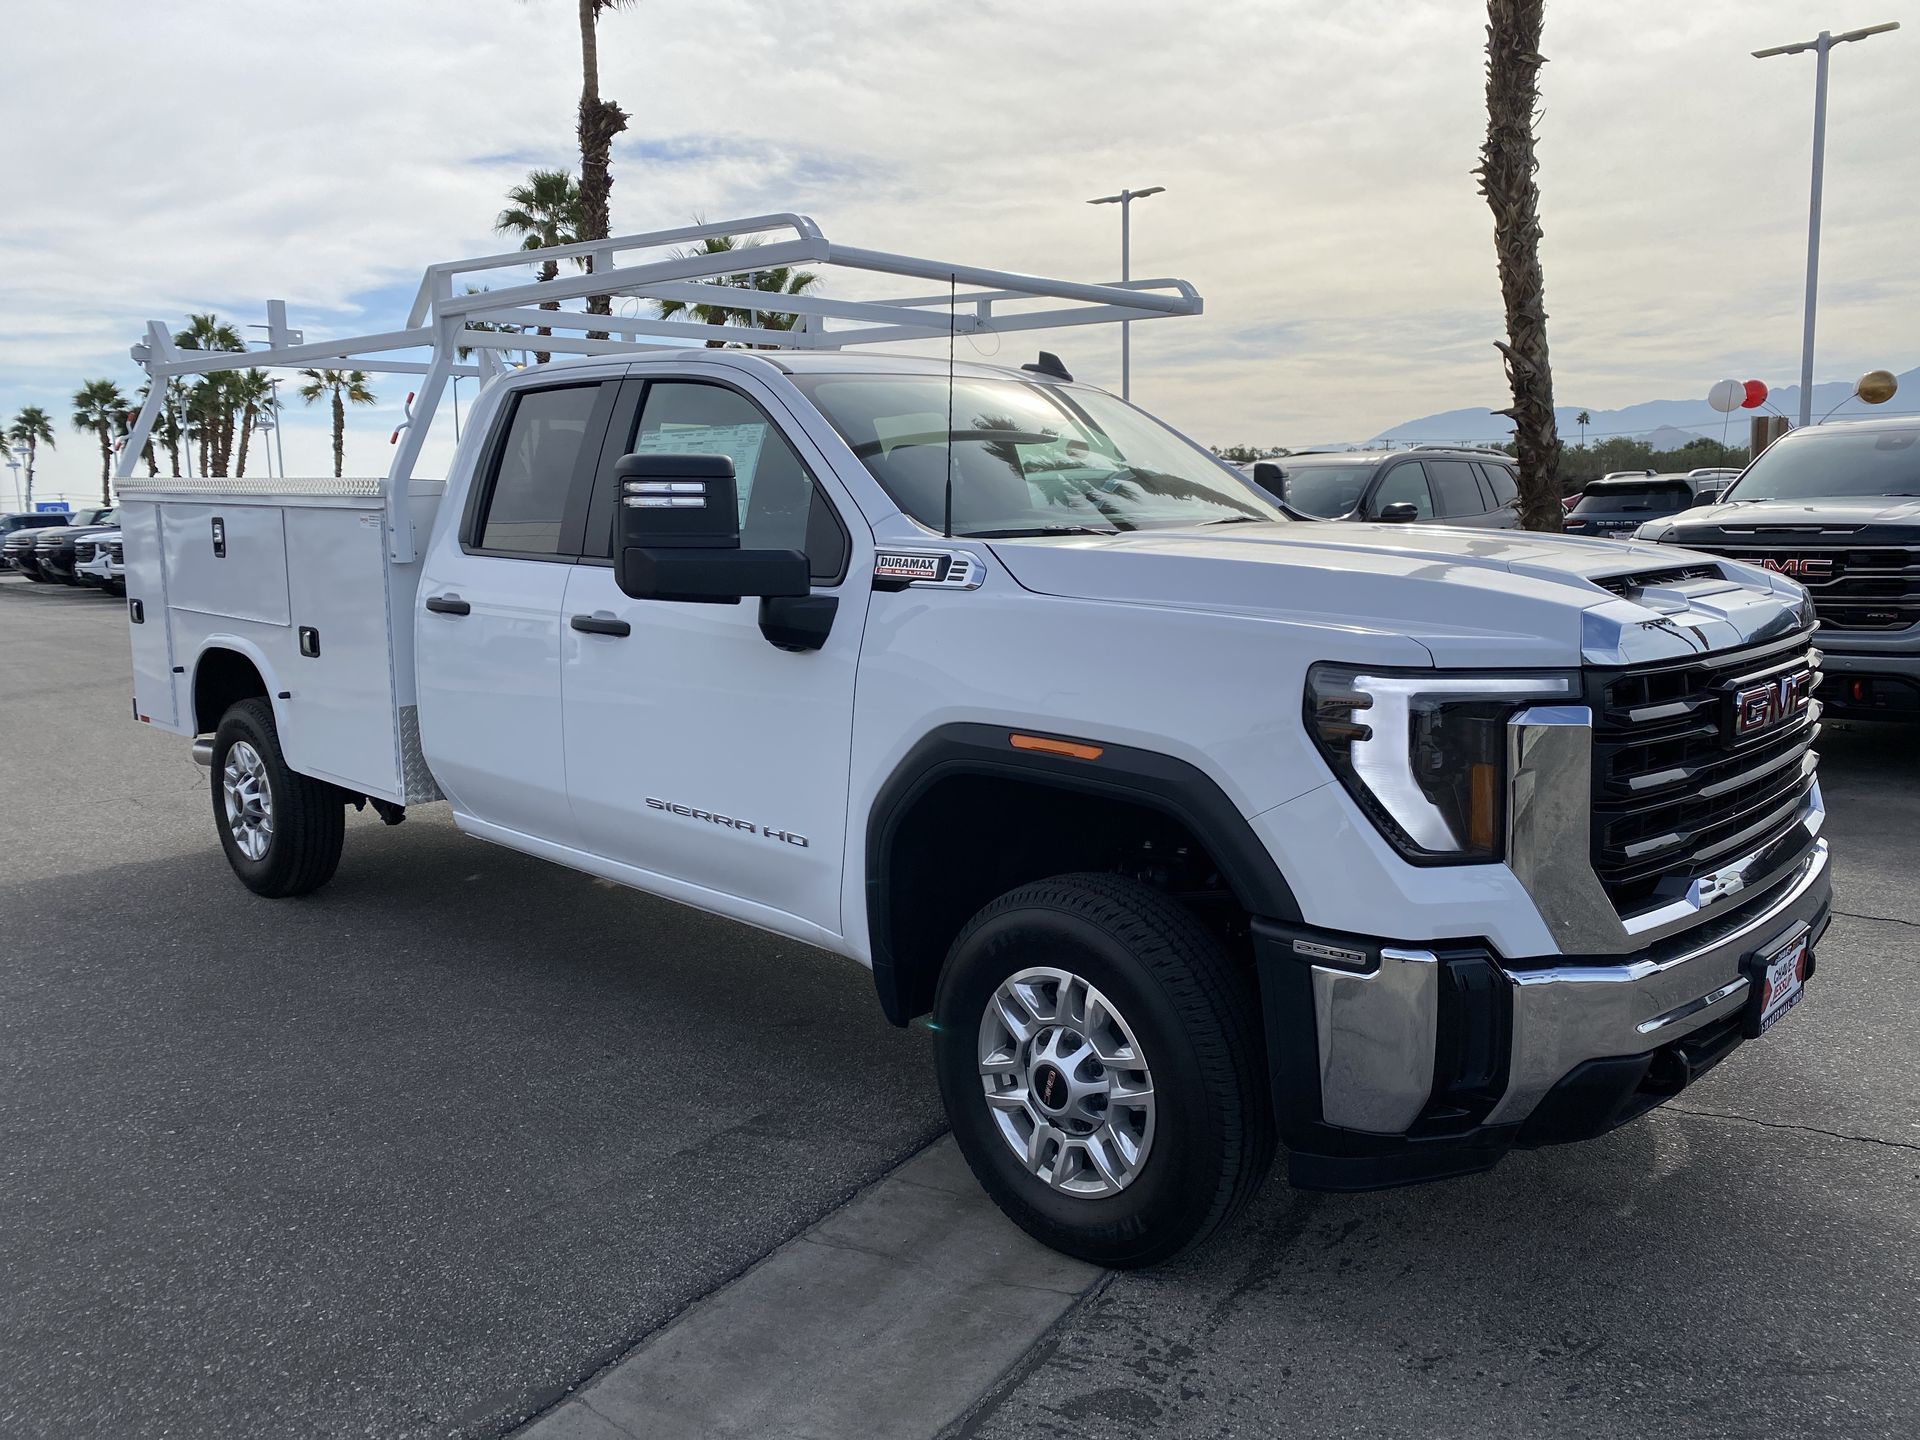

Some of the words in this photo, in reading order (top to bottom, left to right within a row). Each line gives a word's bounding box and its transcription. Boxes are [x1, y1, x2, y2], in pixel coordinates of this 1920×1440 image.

[880, 557, 935, 570] DURAMAX
[1736, 669, 1811, 736] GMC
[645, 796, 756, 833] SIERRA
[763, 825, 810, 848] HD
[1296, 943, 1363, 961] 2500
[1043, 1070, 1056, 1105] GMC
